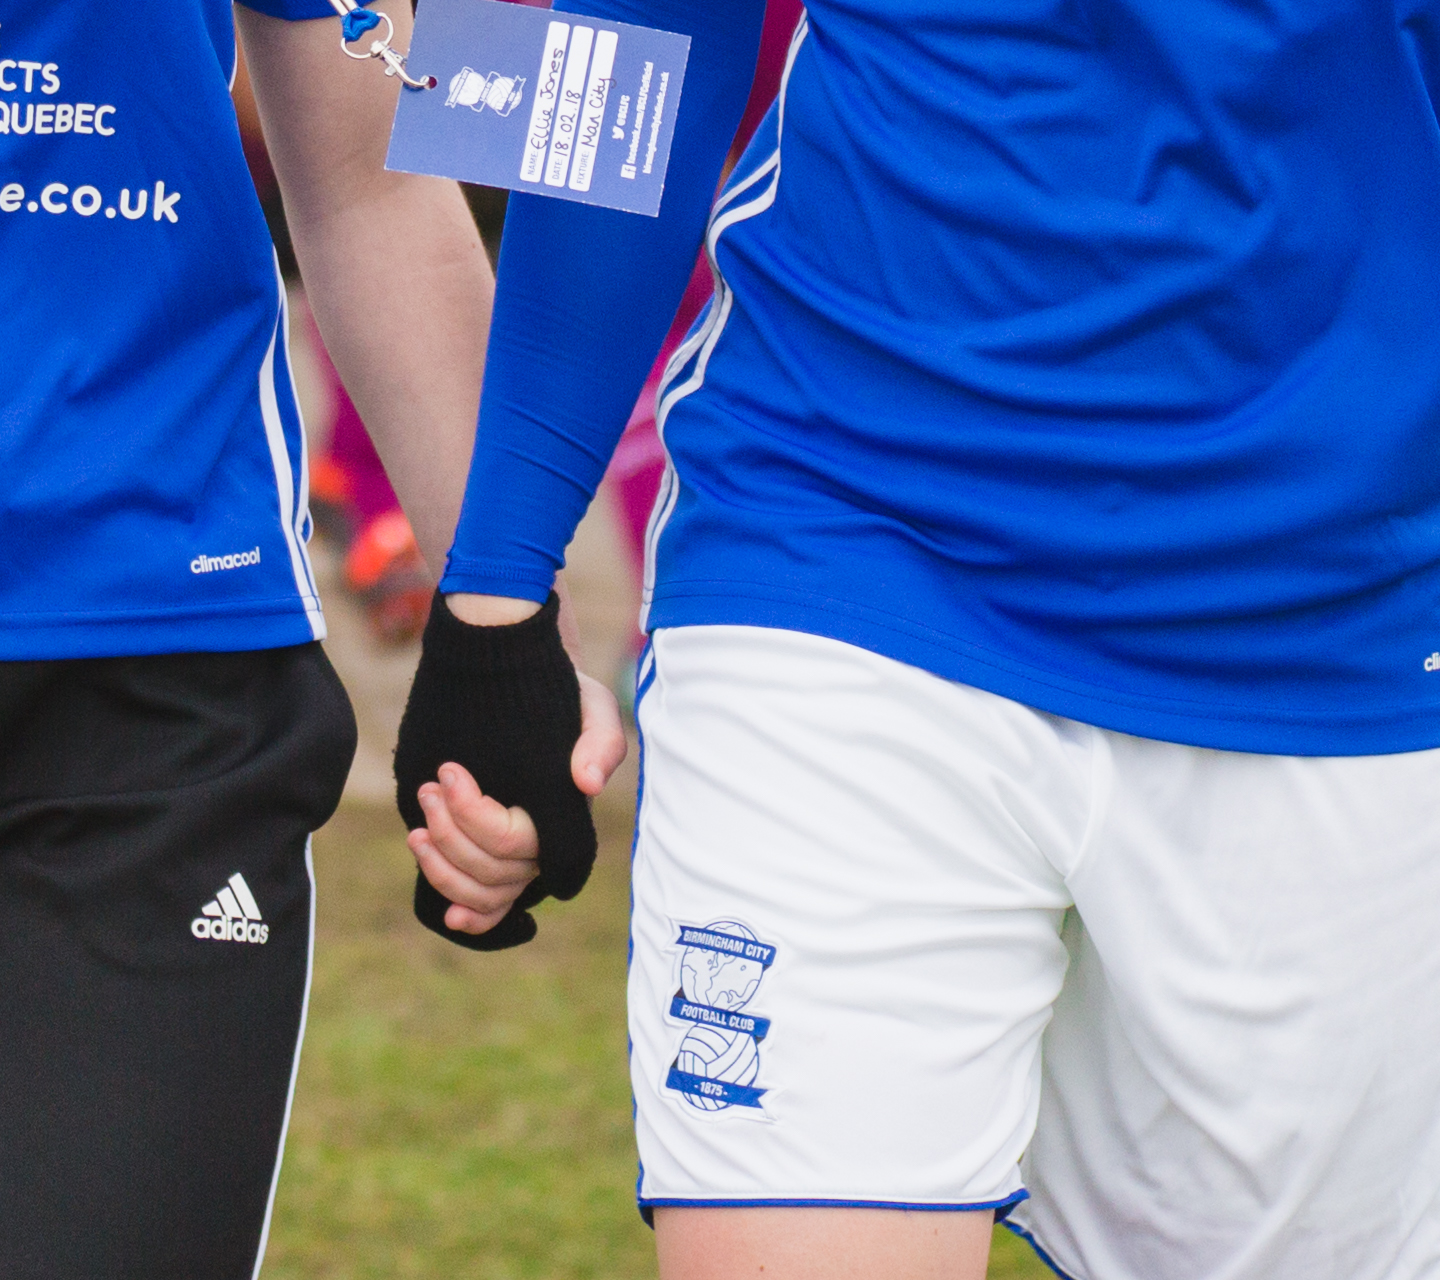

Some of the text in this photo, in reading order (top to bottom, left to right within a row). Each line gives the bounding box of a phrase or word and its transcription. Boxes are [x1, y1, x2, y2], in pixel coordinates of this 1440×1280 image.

[527, 150, 538, 175] NAME:
[540, 48, 563, 99] Jones
[577, 77, 617, 185] FIXTURE: Man City
[552, 158, 563, 179] DATE:
[190, 546, 261, 574] climacool
[191, 915, 270, 944] adidas
[683, 930, 770, 960] BIRMINGHAM CITY
[680, 1004, 755, 1032] FOOTBALL CLUB
